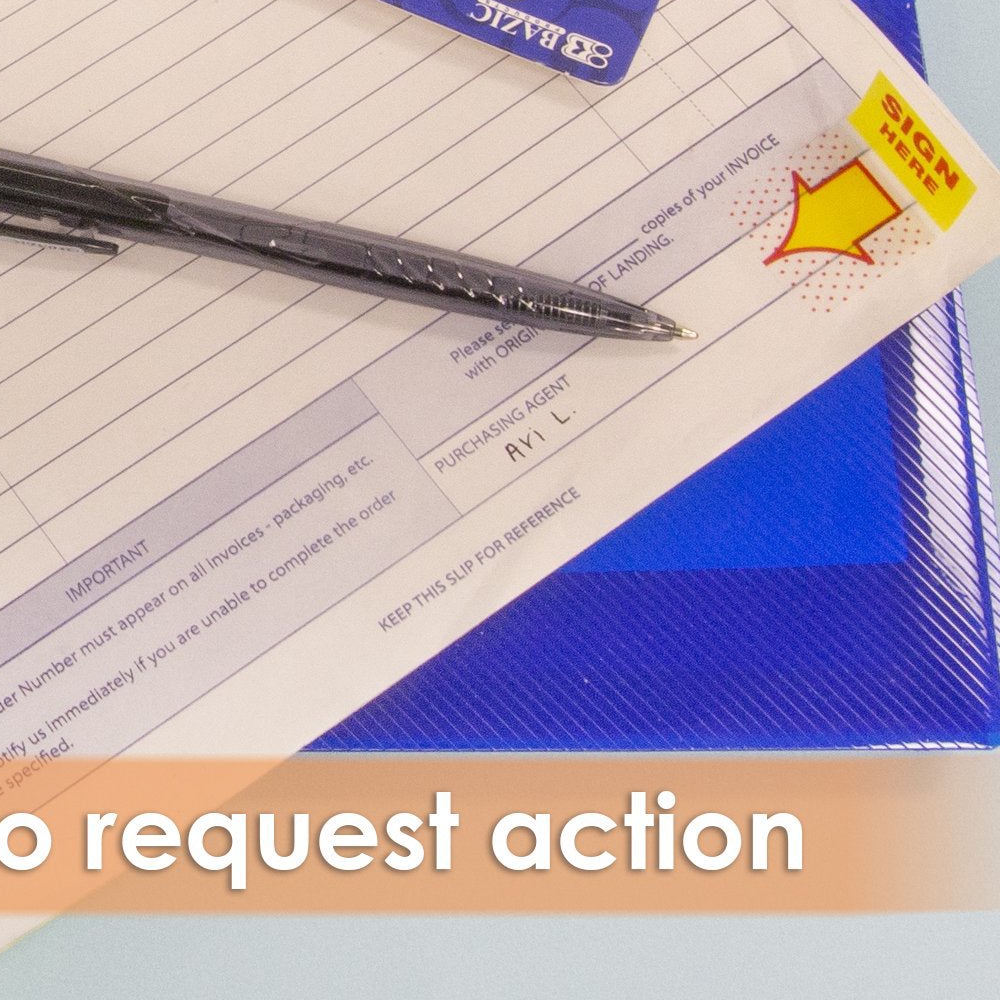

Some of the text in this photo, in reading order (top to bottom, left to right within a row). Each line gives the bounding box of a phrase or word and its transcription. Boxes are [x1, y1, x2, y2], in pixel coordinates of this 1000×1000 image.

[469, 2, 560, 51] BAZIC
[879, 121, 940, 197] HERE
[881, 93, 960, 191] SIGN
[640, 133, 781, 236] copies of your INVOICE
[607, 234, 676, 282] LANDING.
[449, 330, 496, 364] Please
[464, 354, 498, 380] with
[434, 374, 573, 475] PURCHASING AGENT
[17, 650, 79, 698] Number
[79, 626, 119, 657] must
[116, 591, 167, 631] appear
[168, 577, 189, 597] on
[188, 562, 208, 583] all
[272, 473, 348, 529] packaging,
[347, 454, 375, 477] etc.
[64, 538, 150, 604] IMPORTANT
[378, 486, 582, 633] KEEP THIS SLIP FOR REFERENCE
[27, 727, 48, 746] us
[46, 667, 136, 734] immediately
[146, 640, 177, 668] you
[176, 623, 201, 645] are
[201, 590, 251, 629] unable
[250, 577, 267, 594] to
[268, 532, 334, 582] complete
[332, 516, 359, 538] the
[358, 489, 397, 521] order
[5, 736, 75, 790] specified.
